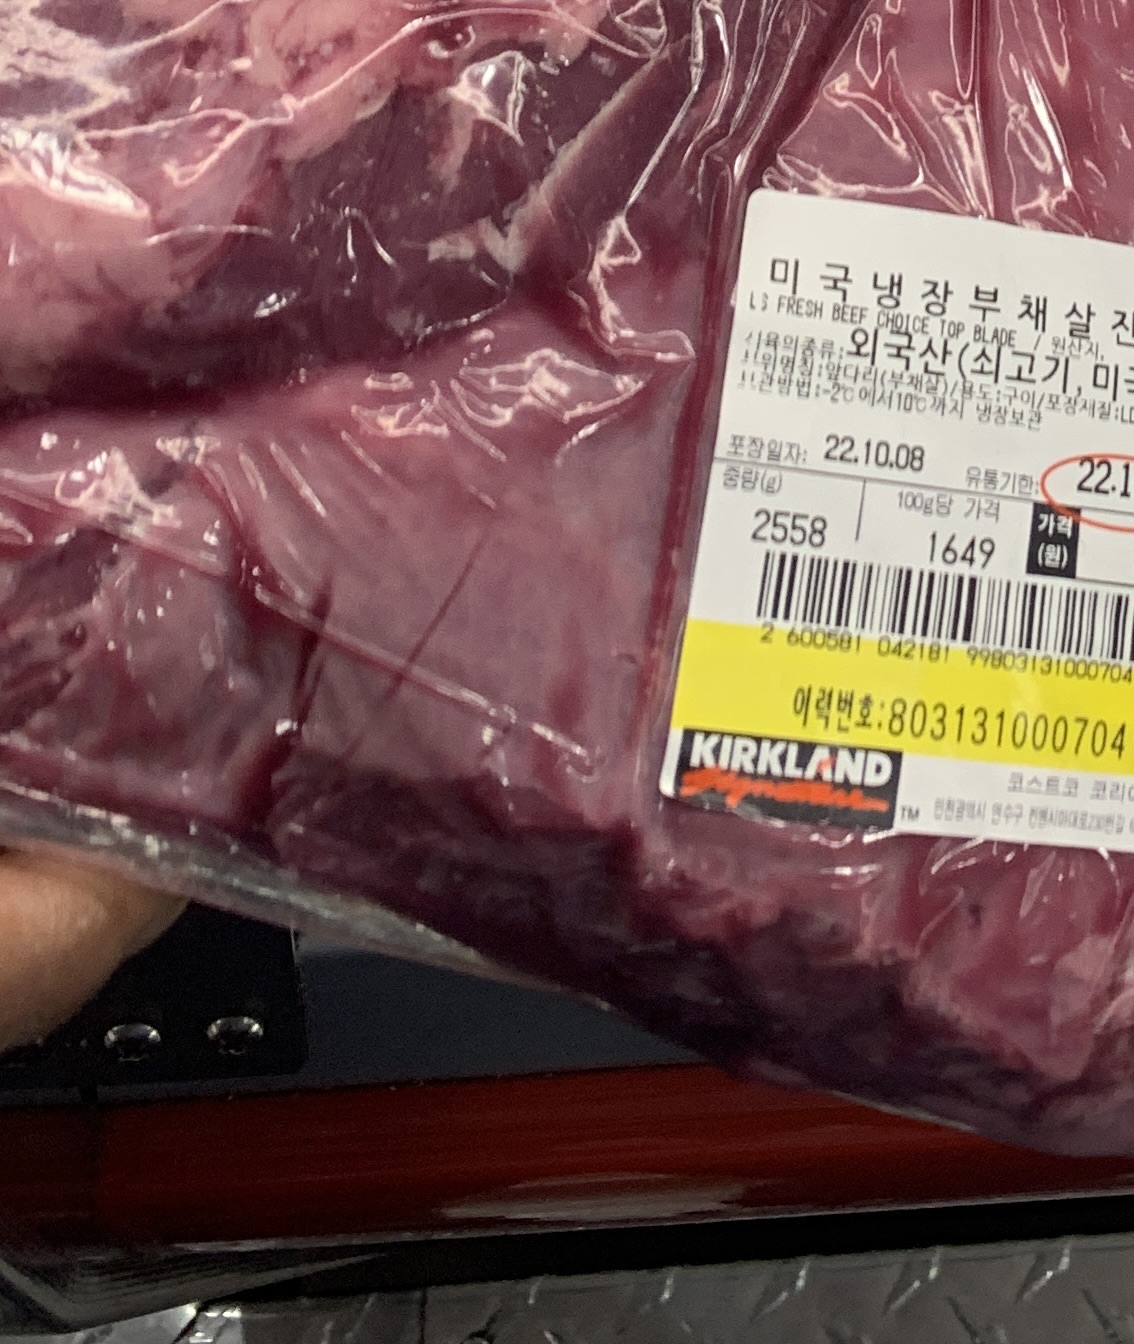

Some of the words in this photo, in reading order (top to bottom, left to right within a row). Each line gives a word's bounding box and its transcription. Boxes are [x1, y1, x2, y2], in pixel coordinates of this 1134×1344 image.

[776, 295, 824, 320] FRESH
[831, 303, 869, 325] BEEF
[877, 310, 930, 335] CHOICE
[939, 319, 965, 339] TOP
[973, 324, 1017, 348] BLADE
[823, 432, 925, 472] 22.10.08
[963, 498, 1001, 523] 가격
[1037, 512, 1074, 539] 가격
[751, 508, 828, 548] 2558
[928, 530, 997, 570] 1649
[759, 621, 774, 644] 2
[786, 628, 862, 655] 600581
[876, 635, 950, 663] 042181
[689, 731, 893, 787] KIRKLAND
